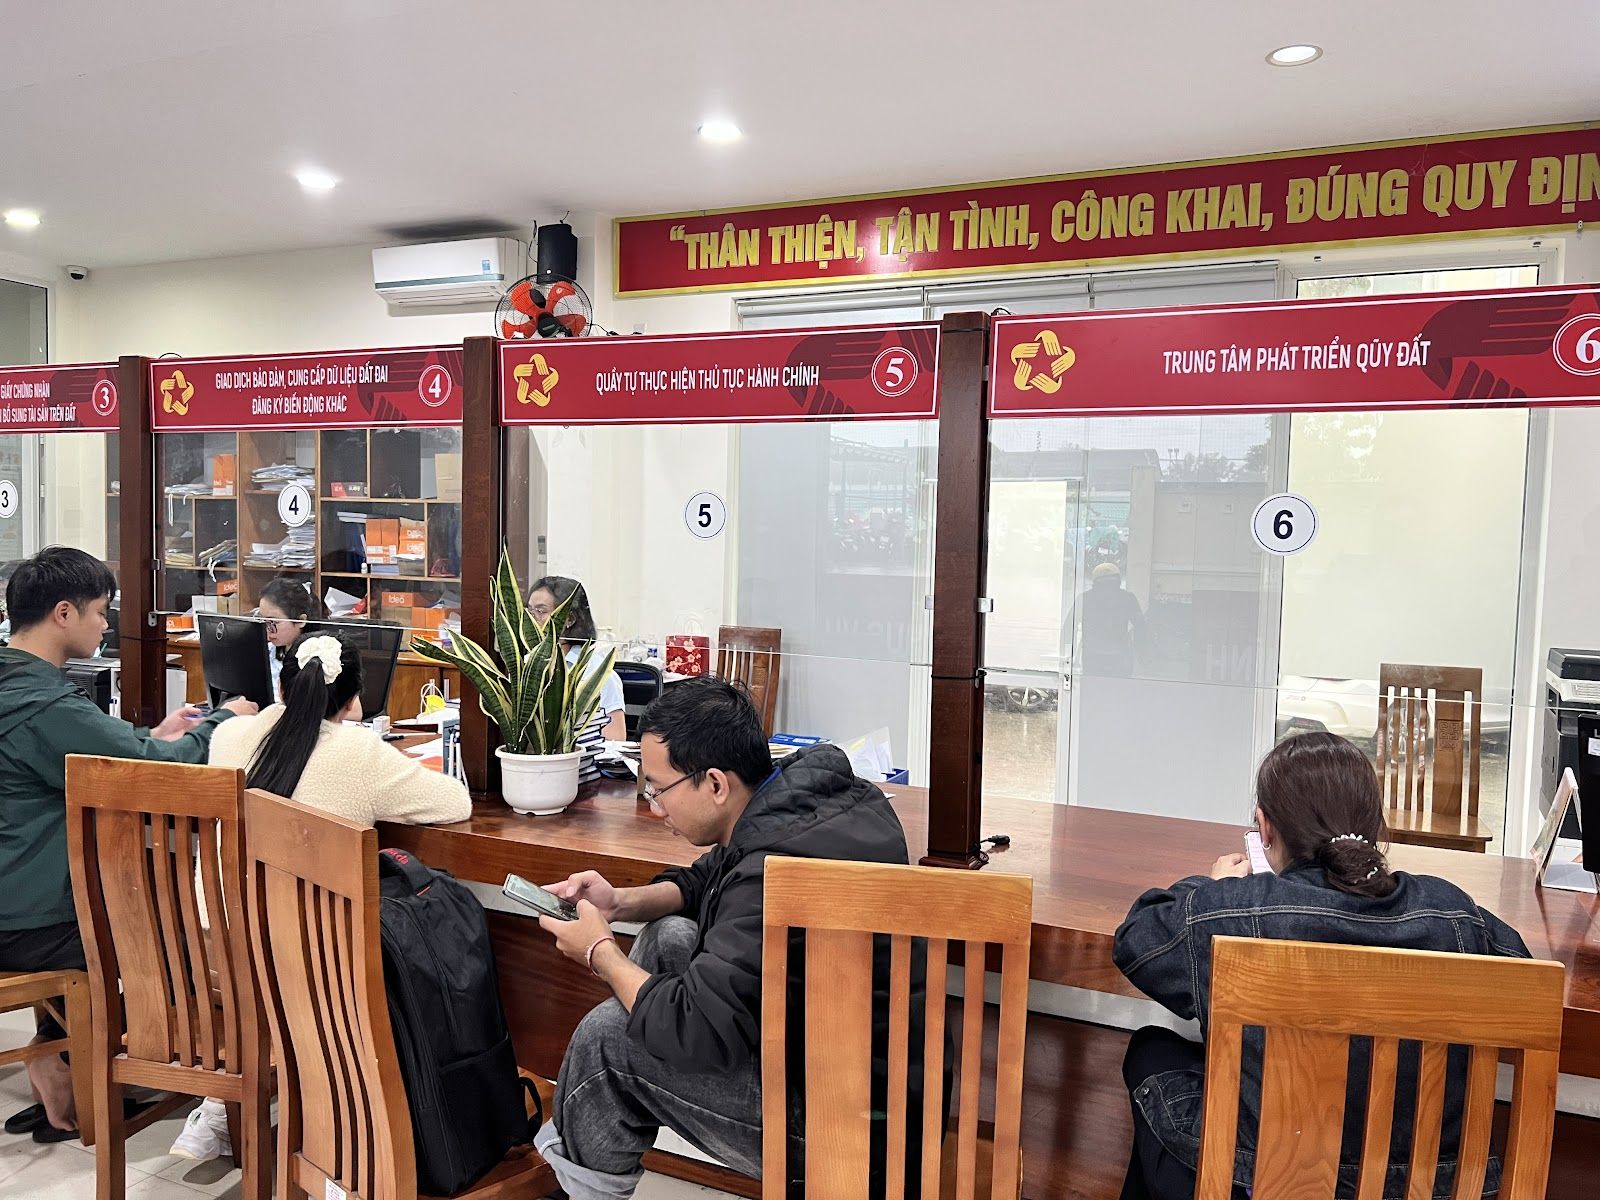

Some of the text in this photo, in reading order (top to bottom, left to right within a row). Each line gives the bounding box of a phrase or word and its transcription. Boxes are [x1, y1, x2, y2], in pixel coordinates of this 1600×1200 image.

[768, 214, 866, 270] THIỆN,
[875, 207, 940, 263] TẬN
[949, 200, 1040, 251] TÌNH,
[1051, 189, 1155, 243] CÔNG
[1165, 182, 1274, 234] KHAI,
[1285, 164, 1409, 224] ĐÚNG
[1422, 159, 1518, 217] QUY
[1163, 333, 1431, 375] TRUNG TÂM PHÁT TRIỂN QŨY ĐẤT
[1575, 326, 1600, 364] 6
[215, 372, 232, 390] GIAO
[233, 371, 251, 392] DỊCH
[253, 366, 267, 389] BẢO
[288, 370, 308, 387] CUNG
[310, 363, 325, 386] CẤP
[327, 364, 339, 385] DỮ
[339, 363, 357, 388] LIỆU
[358, 360, 374, 384] ĐẤT
[374, 365, 388, 383] ĐAI
[428, 373, 442, 398] 4
[596, 361, 819, 396] QUẦY TỰ THỰC HIỆN THỦ TỤC HÀNH CHÍNH
[885, 357, 905, 388] 5
[100, 386, 110, 409] 3
[252, 391, 347, 416] ĐĂNG KÝ BIẾN ĐỘNG KHÁC
[11, 407, 27, 423] SUNG
[28, 404, 37, 422] TÀI
[37, 403, 49, 422] SẢN
[49, 404, 64, 422] TRÊN
[65, 402, 76, 421] ĐẤT
[1, 490, 9, 508] 3
[288, 494, 299, 515] 4
[697, 503, 713, 528] 5
[1272, 509, 1294, 541] 6
